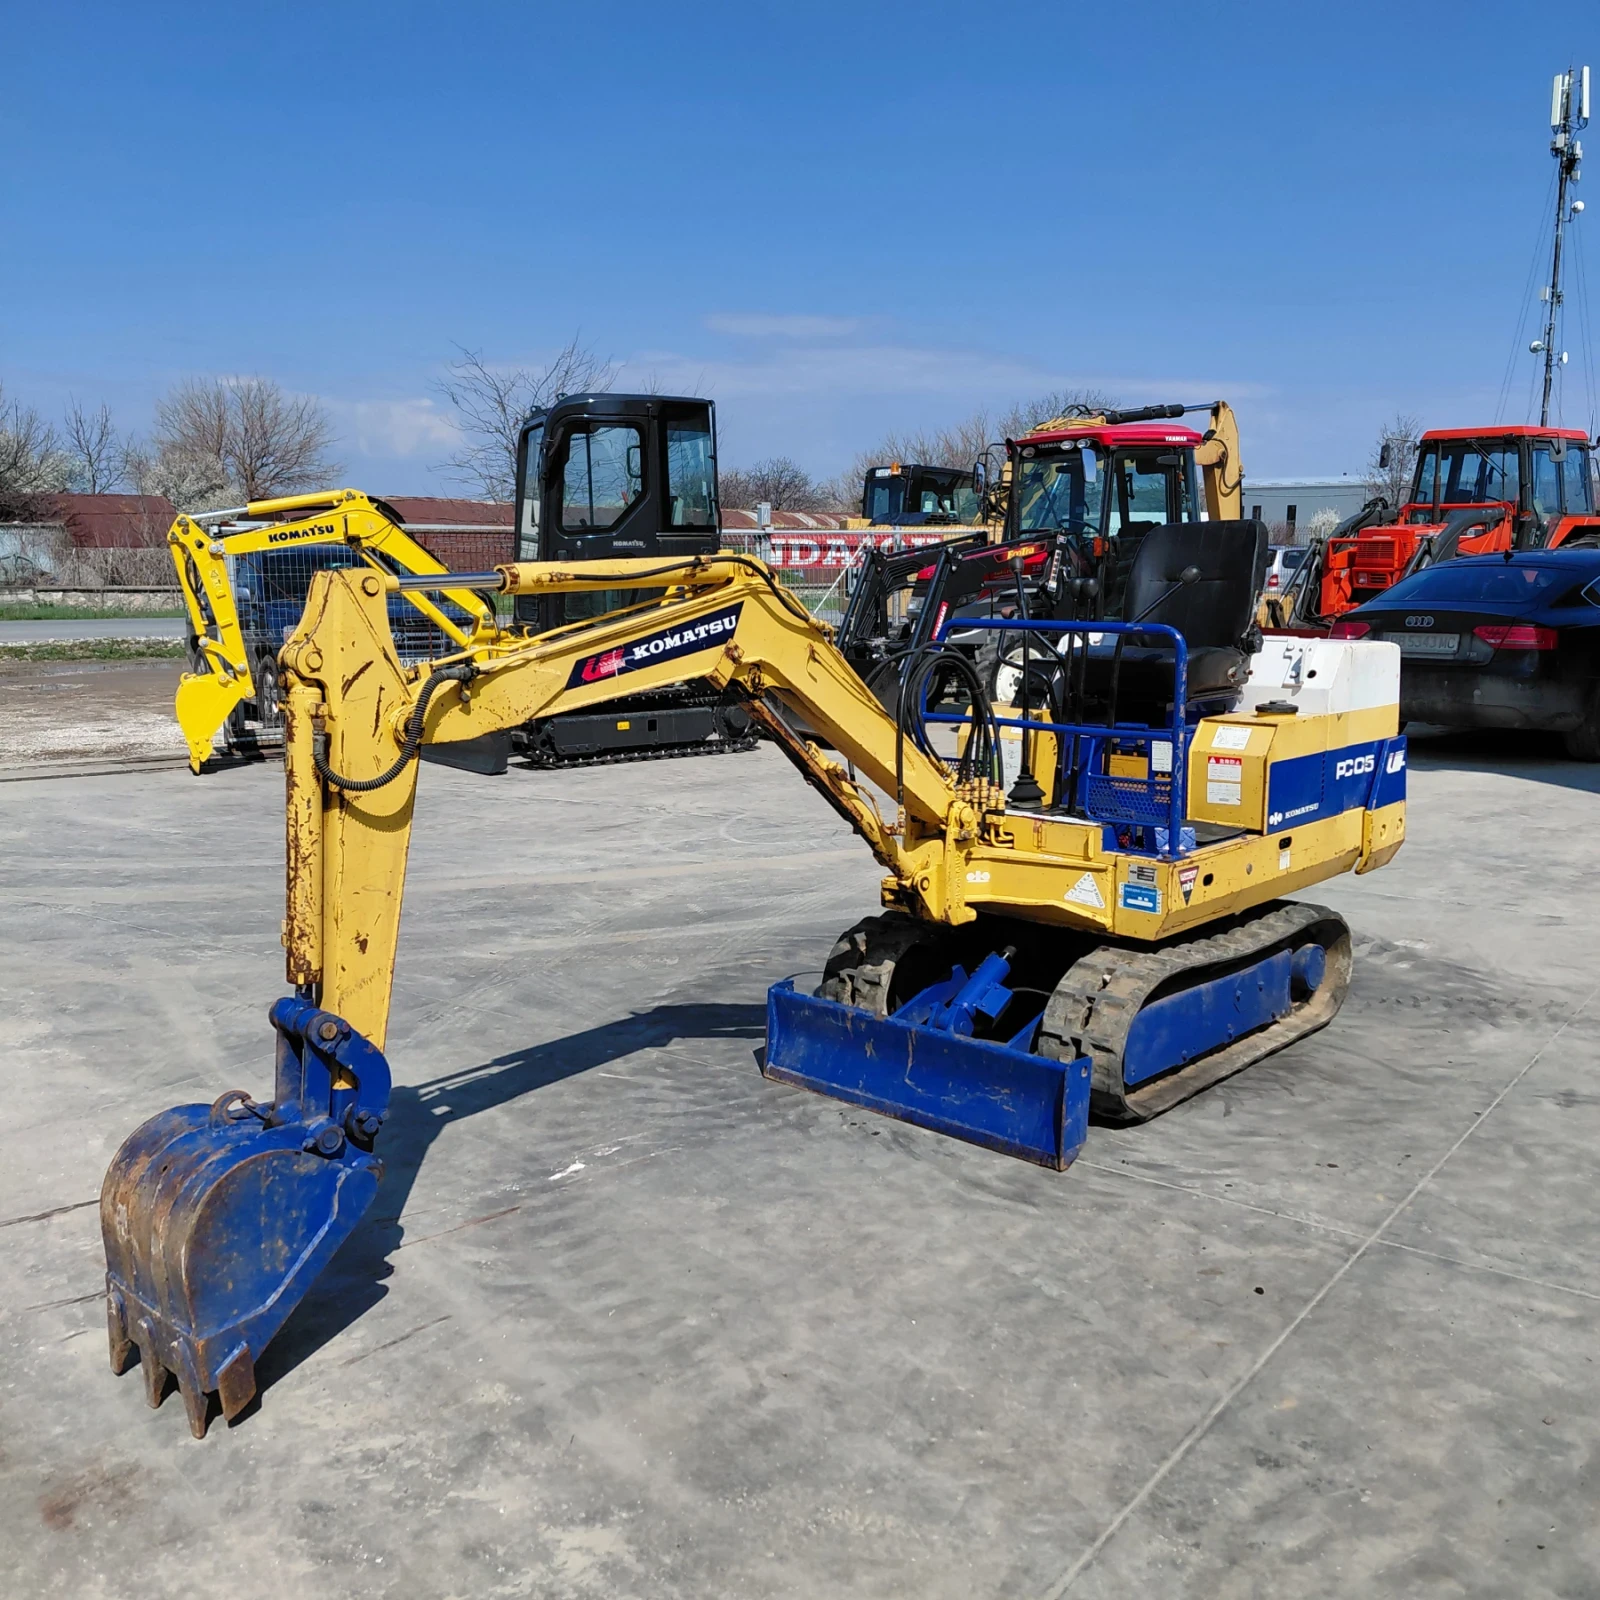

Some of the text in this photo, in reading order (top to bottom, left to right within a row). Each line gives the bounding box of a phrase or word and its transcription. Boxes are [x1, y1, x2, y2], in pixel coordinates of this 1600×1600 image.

[268, 525, 335, 543] KOMATSU
[632, 615, 737, 661] KOMATSU
[1335, 754, 1375, 780] PC05
[1284, 803, 1319, 819] KOMATSU
